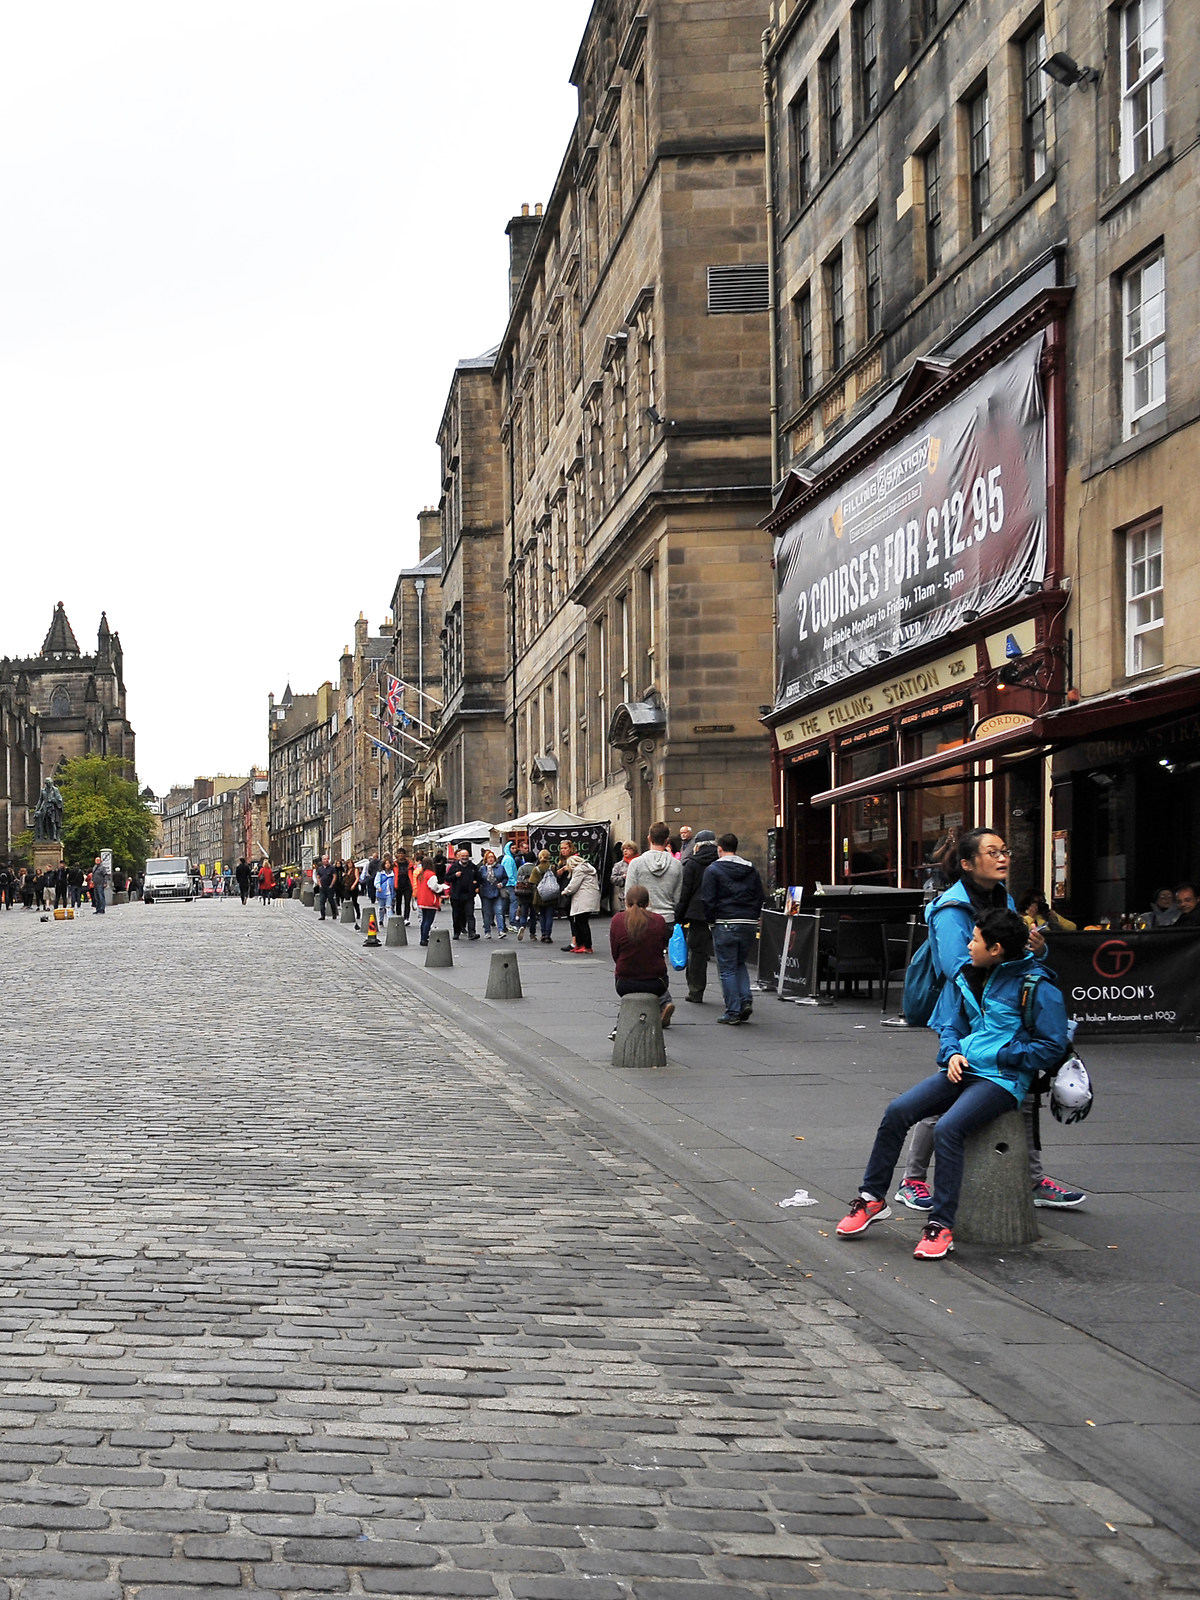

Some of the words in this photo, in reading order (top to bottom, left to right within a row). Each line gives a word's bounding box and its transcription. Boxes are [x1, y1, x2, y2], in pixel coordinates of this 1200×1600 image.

[843, 483, 877, 518] FILLING
[798, 591, 809, 642] 2
[811, 544, 880, 633] COURSES
[884, 519, 920, 592] FOR
[926, 464, 1005, 570] £12.95
[823, 625, 851, 651] Available
[851, 609, 878, 637] Monday
[877, 607, 886, 620] to
[886, 593, 912, 616] Friday,
[913, 583, 936, 602] 11am
[943, 568, 965, 590] 5pm
[798, 715, 822, 737] THE
[828, 695, 874, 727] FILLING
[882, 668, 940, 704] STATION
[921, 707, 939, 718] WINES
[942, 699, 964, 712] SPIRITS
[1071, 985, 1155, 1001] GORDON'S
[1085, 1013, 1106, 1022] Italian
[1107, 1012, 1142, 1021] Restaurant
[1143, 1013, 1153, 1021] est
[1155, 1011, 1177, 1021] 1982
